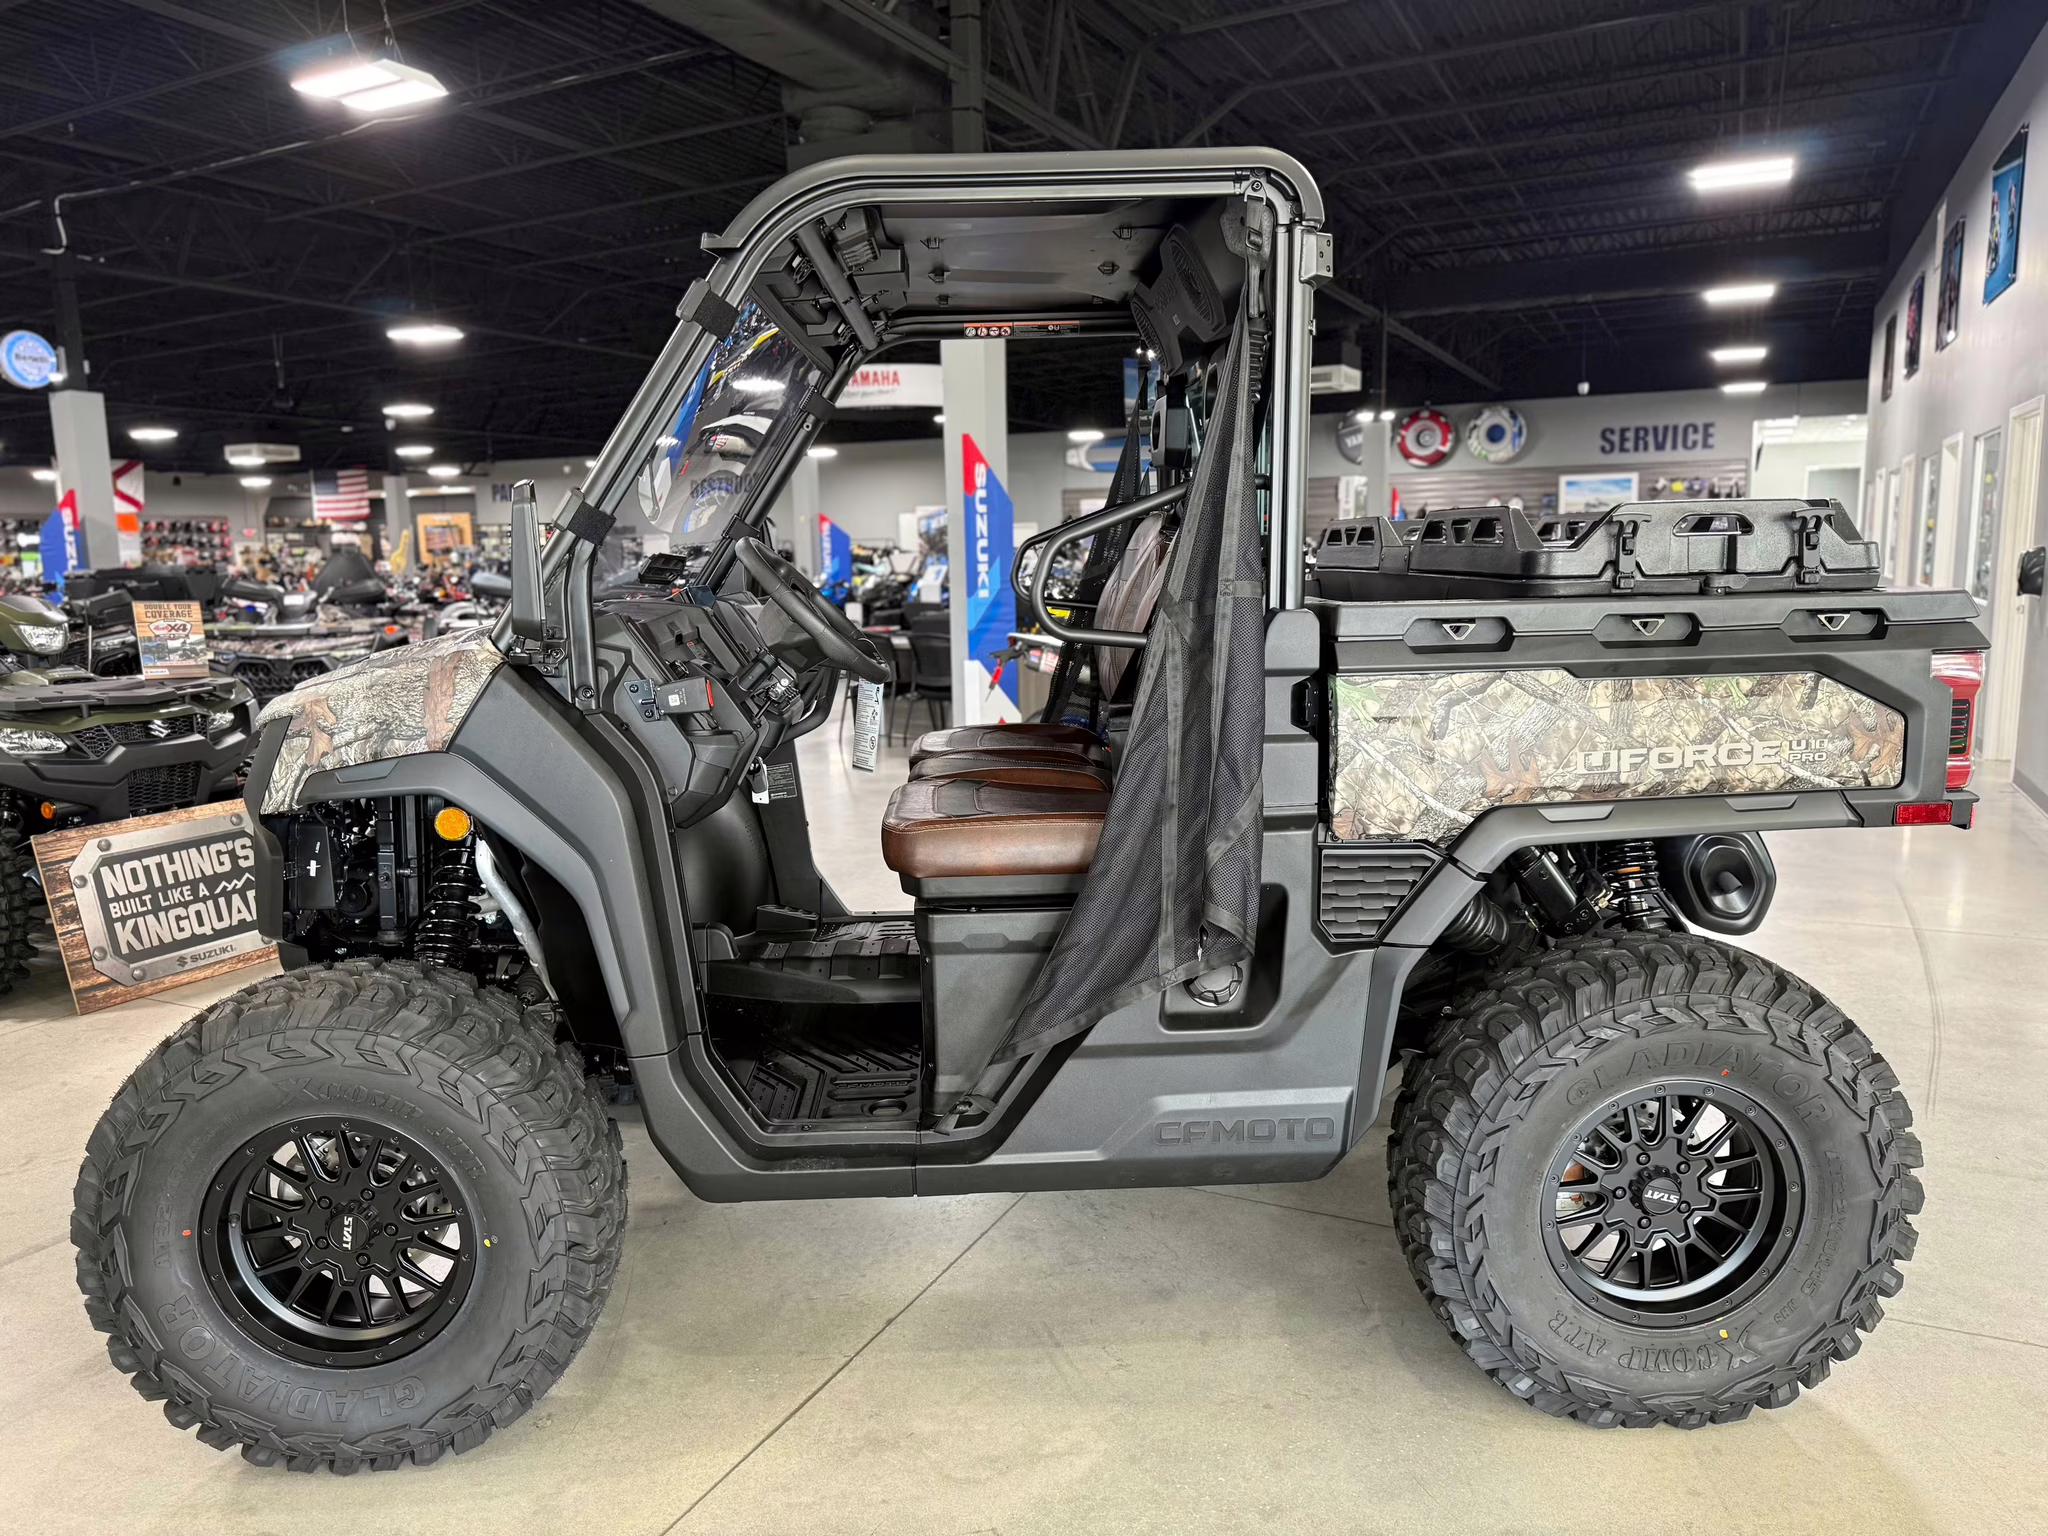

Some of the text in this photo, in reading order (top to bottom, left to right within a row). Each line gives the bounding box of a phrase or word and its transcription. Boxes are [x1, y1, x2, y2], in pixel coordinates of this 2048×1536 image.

[850, 371, 901, 387] AMAHA
[1600, 422, 1715, 455] SERVICE
[974, 461, 990, 599] SUZUKI
[144, 610, 193, 619] COVERAGE
[1789, 752, 1828, 763] PRO
[100, 836, 255, 899] NOTHING'S
[109, 882, 211, 918] BUILT LIKE A
[189, 943, 235, 963] SUZUKI
[1566, 1041, 1834, 1129] GLADIATOR
[1153, 1116, 1336, 1146] CFMOTO
[1643, 1189, 1680, 1204] STAT
[342, 1215, 353, 1251] STAT
[156, 1293, 427, 1423] GLADIATOR
